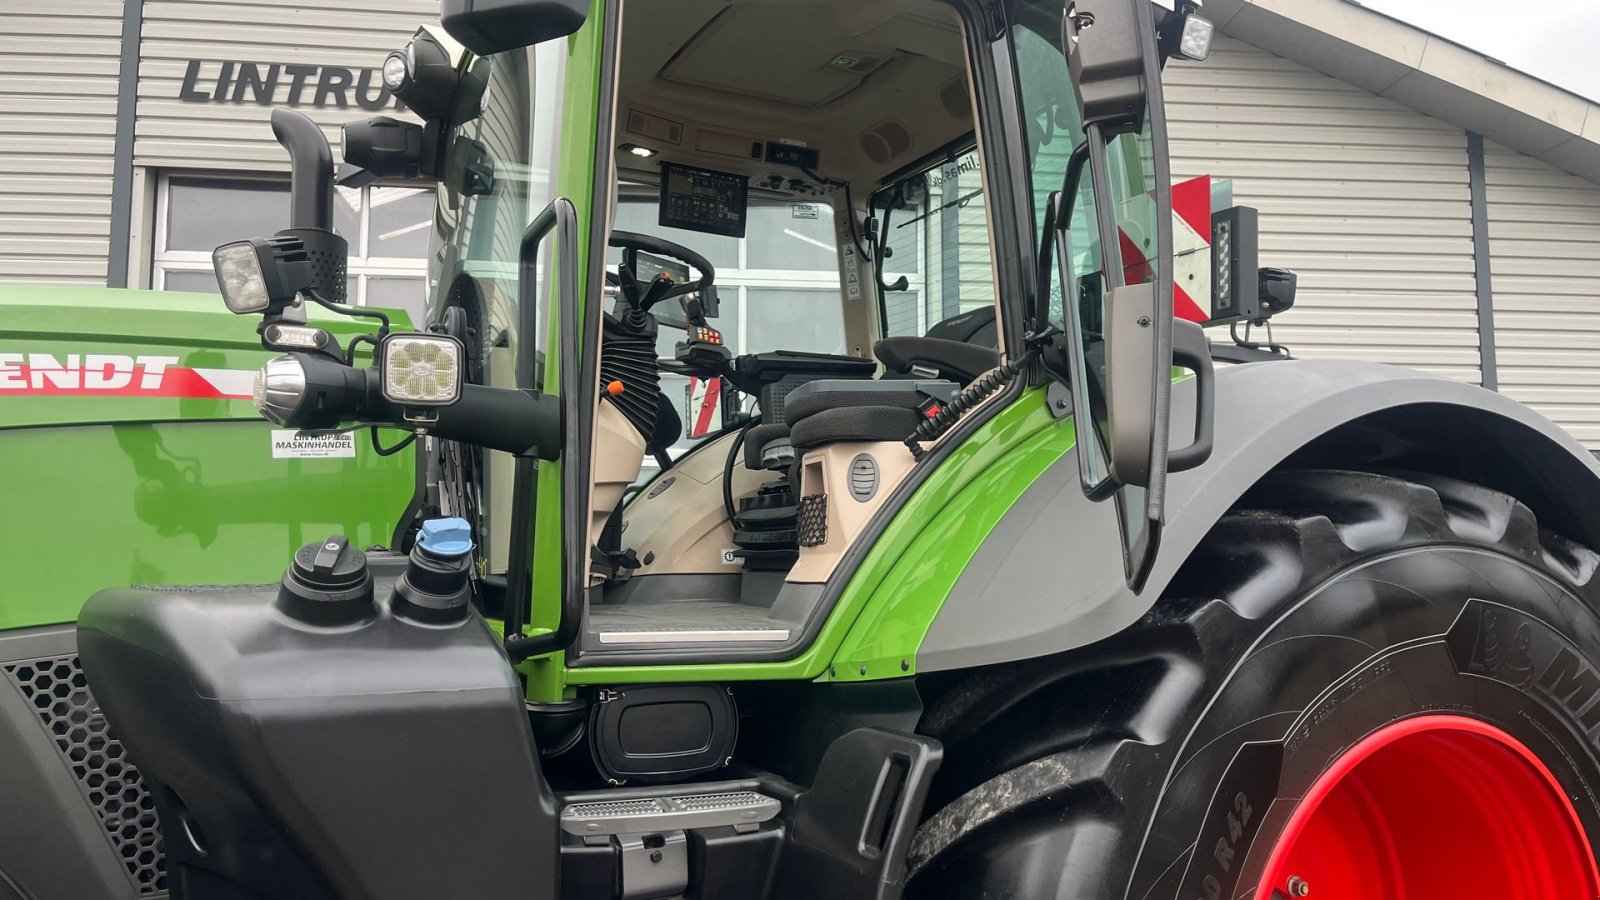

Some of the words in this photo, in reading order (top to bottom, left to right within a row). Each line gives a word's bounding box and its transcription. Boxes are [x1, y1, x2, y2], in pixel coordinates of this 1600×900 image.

[179, 59, 407, 111] LINTRU
[275, 441, 352, 449] MASKINHANDEL
[1213, 791, 1253, 873] R42
